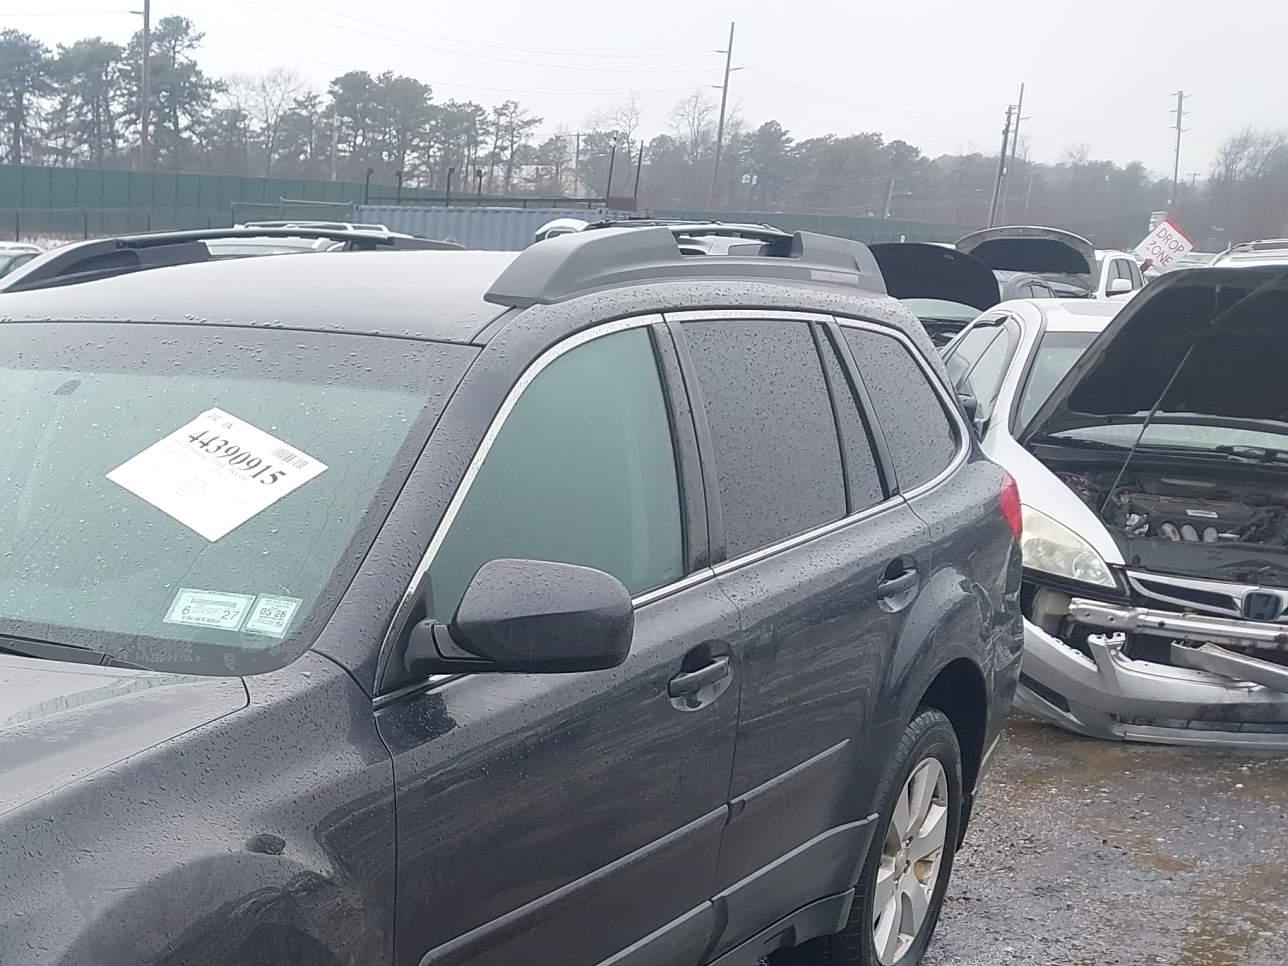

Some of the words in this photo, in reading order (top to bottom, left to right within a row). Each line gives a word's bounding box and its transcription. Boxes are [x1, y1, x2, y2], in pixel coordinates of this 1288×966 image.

[1145, 240, 1173, 266] ZONE
[1156, 227, 1184, 254] DROP
[187, 430, 287, 486] 44390915
[221, 609, 240, 621] 27
